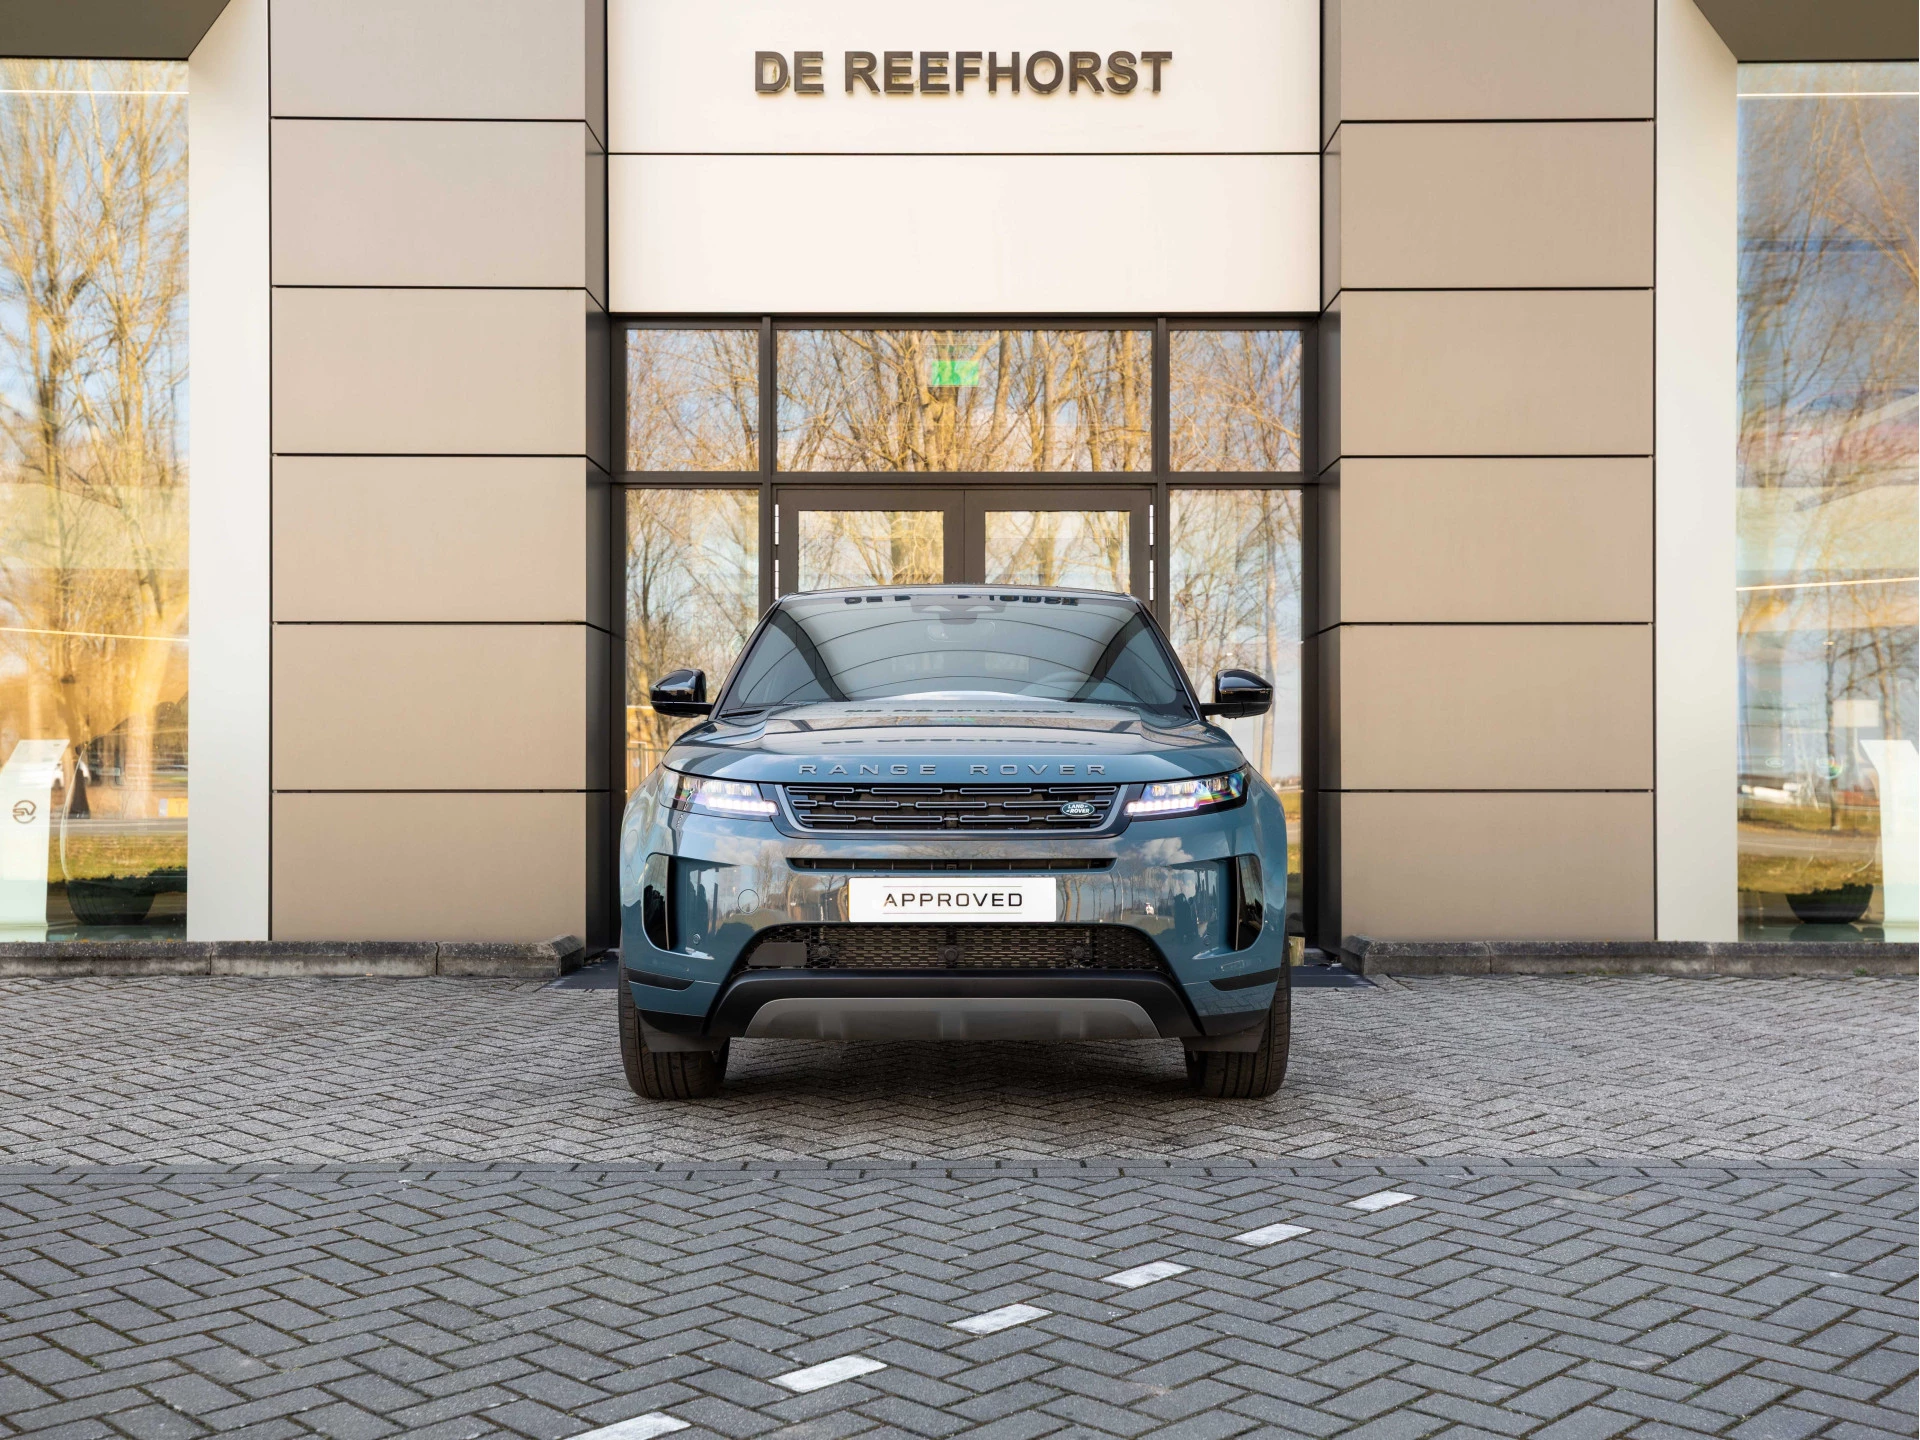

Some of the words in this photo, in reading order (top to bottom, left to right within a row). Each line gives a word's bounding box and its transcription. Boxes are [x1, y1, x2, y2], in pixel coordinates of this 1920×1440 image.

[754, 51, 825, 94] DE
[844, 50, 1173, 94] REEFHORST
[798, 764, 937, 775] RANGE
[969, 764, 1106, 775] ROVER
[884, 893, 1023, 907] APPROVED
